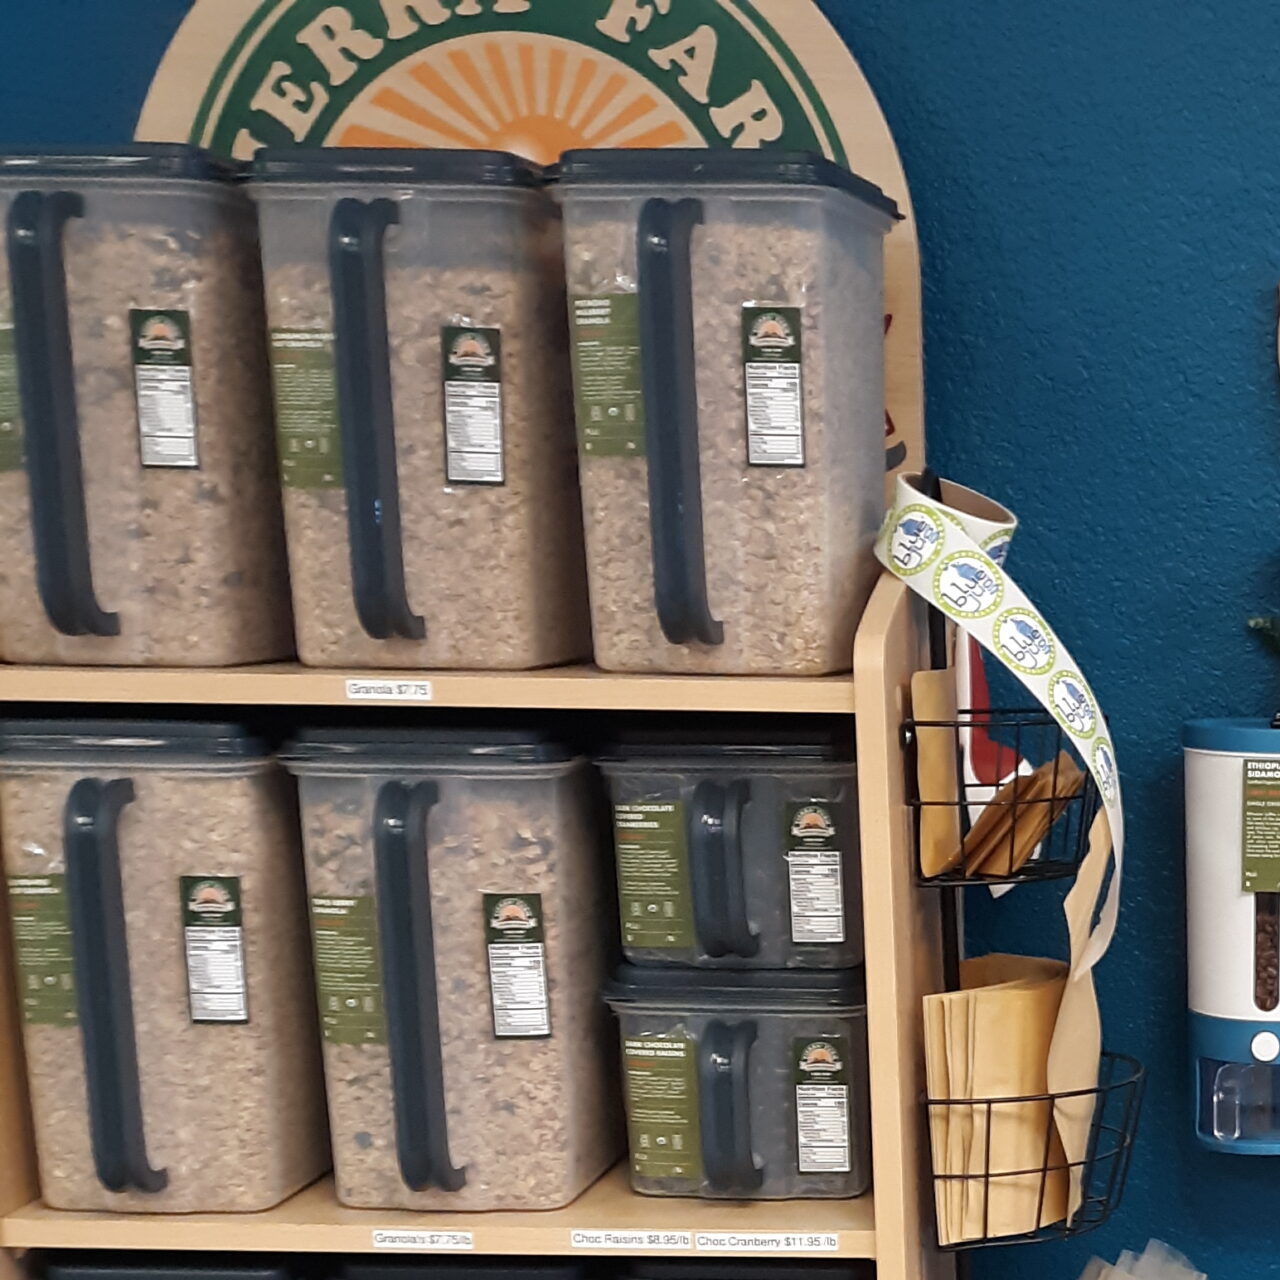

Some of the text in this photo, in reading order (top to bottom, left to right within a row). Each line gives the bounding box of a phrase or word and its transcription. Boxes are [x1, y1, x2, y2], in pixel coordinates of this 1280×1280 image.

[349, 683, 393, 695] Granola
[573, 1233, 602, 1244] Choc
[604, 1234, 644, 1244] Raisins
[697, 1236, 727, 1247] Choc
[728, 1236, 781, 1249] Cranberry
[784, 1237, 821, 1247] $11.95
